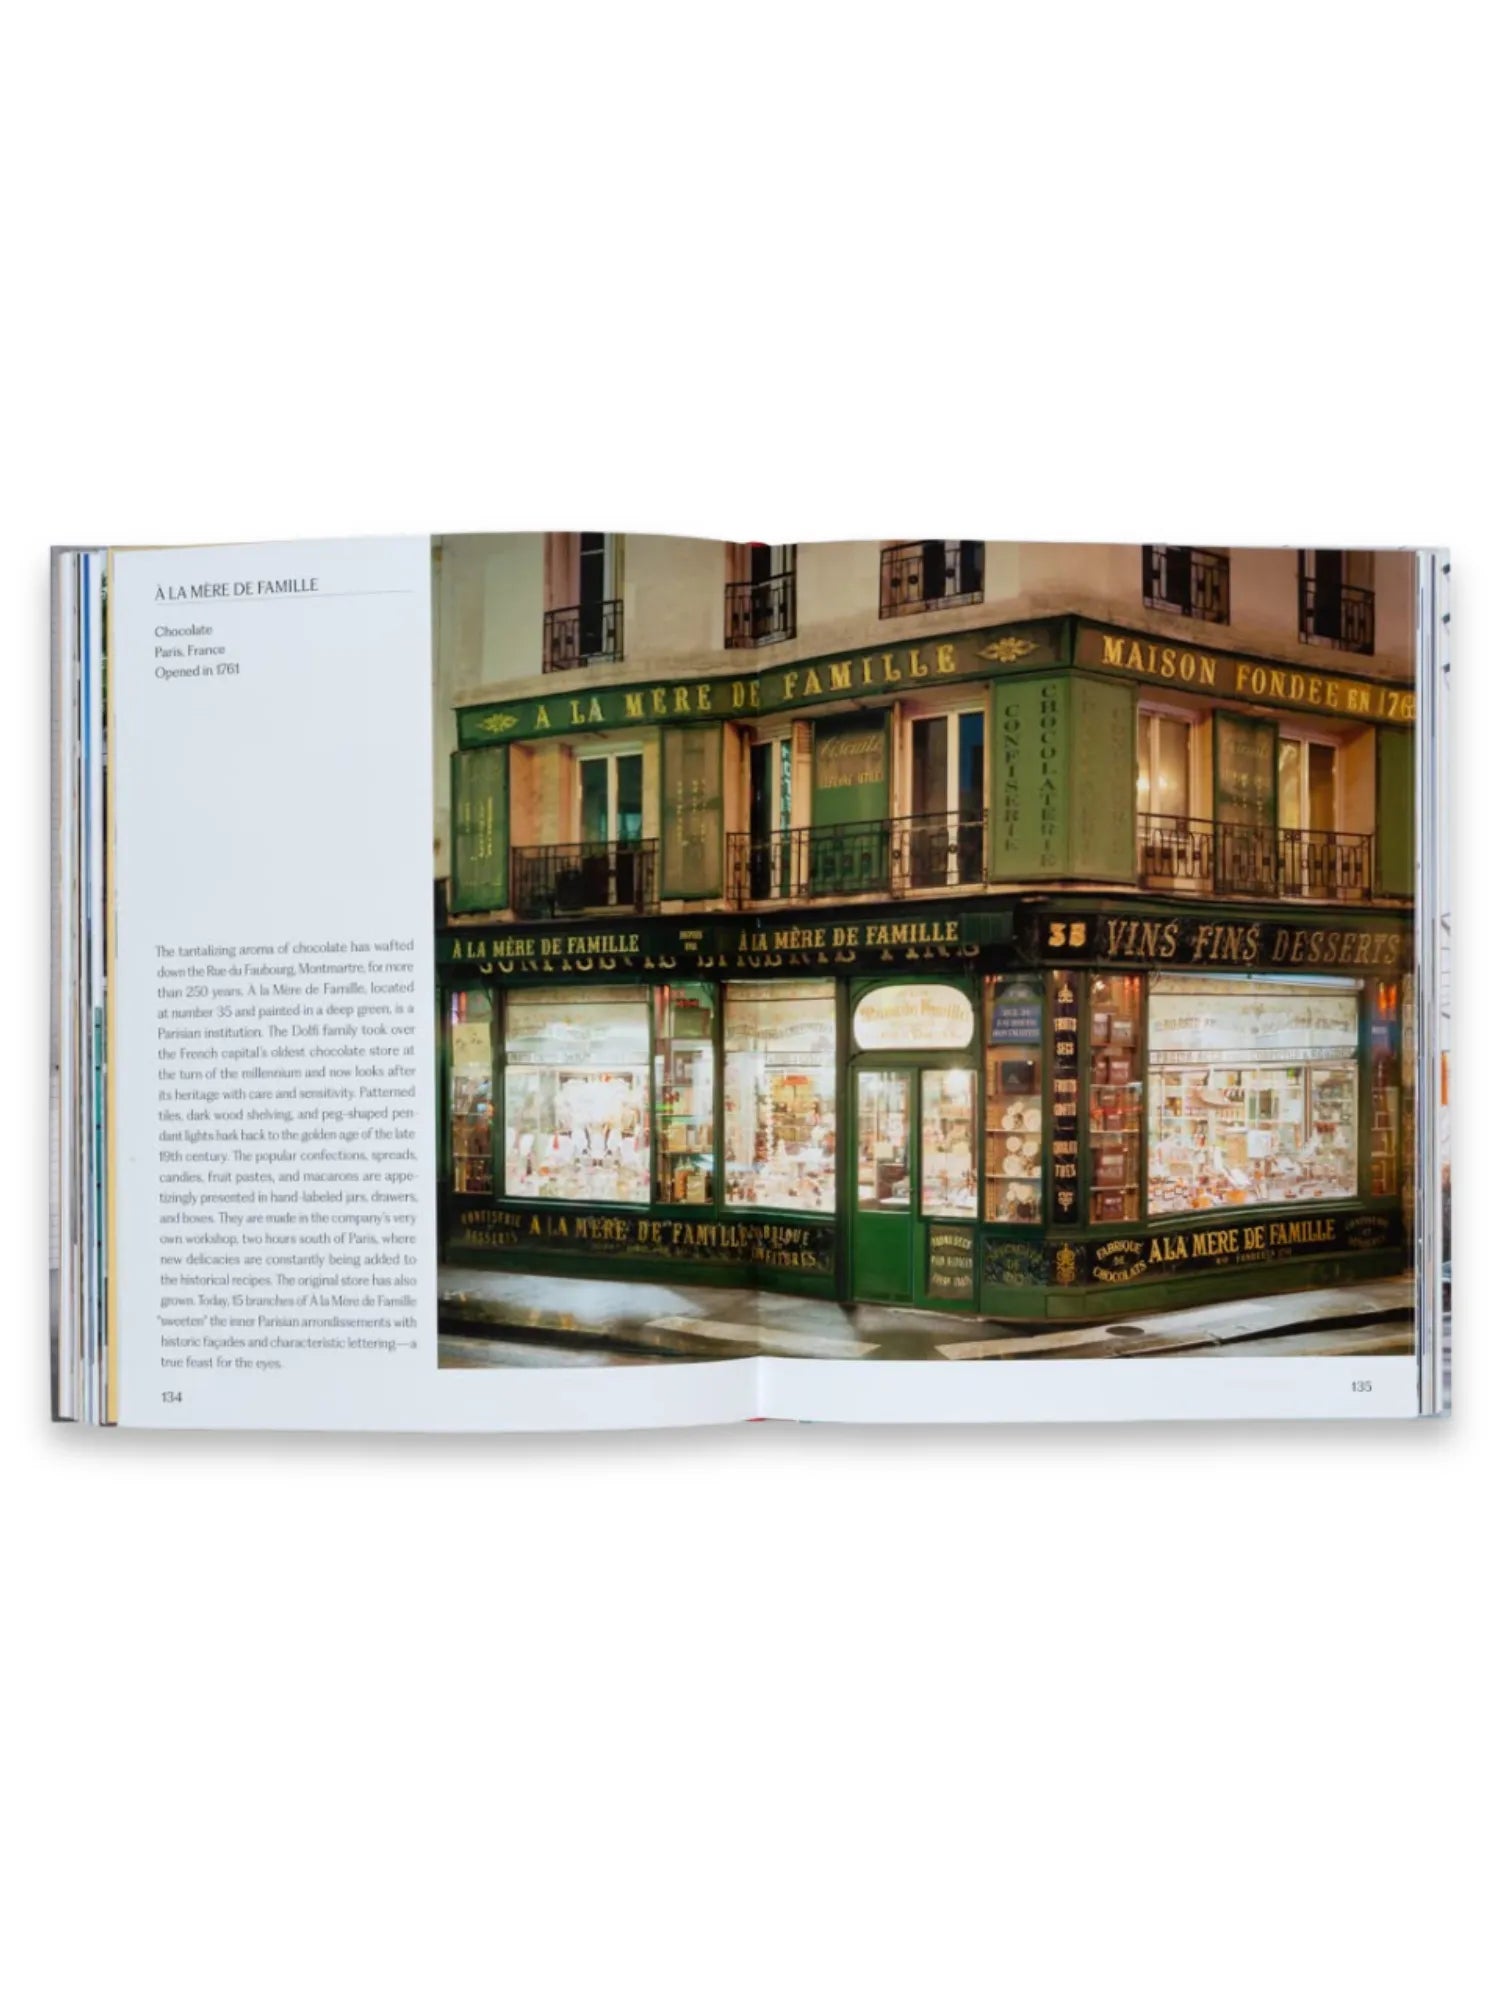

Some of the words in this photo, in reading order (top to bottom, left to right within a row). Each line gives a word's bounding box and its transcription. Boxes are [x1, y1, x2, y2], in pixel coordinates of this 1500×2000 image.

[154, 585, 165, 601] À
[168, 584, 187, 600] LA
[190, 582, 231, 599] MÈRE
[234, 580, 254, 597] DE
[256, 577, 319, 596] FAMILLE
[154, 623, 214, 636] Chocolate
[187, 643, 226, 656] France
[154, 664, 200, 681] Opened
[202, 664, 214, 677] in
[216, 663, 240, 676] 1761
[1102, 635, 1217, 686] MAISON
[1235, 663, 1339, 708] FONDEE
[1347, 687, 1371, 713] EN
[569, 697, 604, 724] LA
[732, 680, 760, 709] DE
[783, 643, 957, 701] FAMILLE
[1004, 704, 1020, 852] CONFISERIE
[1039, 684, 1057, 867] CHOCOLATERIE
[751, 932, 768, 951] LA
[773, 925, 826, 950] MÈRE
[832, 926, 859, 947] DE
[865, 920, 959, 946] FAMILLE
[1048, 922, 1086, 948] 35
[1106, 918, 1178, 959] VINS
[1191, 923, 1261, 963] FINS
[1272, 929, 1401, 964] DESSERTS
[155, 944, 176, 957] The
[178, 943, 237, 959] tantalizing
[239, 944, 275, 955] aroma
[277, 942, 290, 954] of
[292, 941, 348, 954] chocolate
[350, 940, 372, 953] has
[374, 939, 414, 953] wafted
[452, 939, 462, 960] À
[466, 941, 487, 959] LA
[492, 935, 535, 957] MÈRE
[542, 938, 562, 956] DE
[567, 934, 639, 955] FAMILLE
[157, 965, 186, 978] down
[188, 964, 205, 977] the
[207, 964, 227, 977] Rue
[229, 964, 242, 976] du
[368, 961, 383, 973] for
[385, 962, 414, 973] more
[157, 985, 183, 998] than
[185, 984, 209, 997] 250
[260, 983, 270, 996] la
[305, 982, 321, 995] de
[370, 981, 415, 994] located
[157, 1006, 169, 1019] at
[171, 1005, 214, 1019] number
[216, 1005, 233, 1018] 35
[235, 1005, 256, 1018] and
[258, 1004, 301, 1020] painted
[303, 1004, 314, 1016] in
[326, 1003, 355, 1019] deep
[394, 1002, 404, 1015] is
[158, 1026, 202, 1039] Parisian
[266, 1025, 289, 1037] The
[322, 1024, 358, 1040] family
[360, 1023, 388, 1036] took
[390, 1025, 416, 1036] over
[158, 1047, 177, 1059] the
[179, 1046, 219, 1059] French
[270, 1045, 306, 1058] oldest
[308, 1044, 367, 1058] chocolate
[369, 1044, 400, 1057] store
[402, 1044, 415, 1057] at
[186, 1108, 211, 1120] dark
[213, 1107, 244, 1120] wood
[297, 1107, 319, 1119] and
[232, 1149, 253, 1162] The
[255, 1149, 297, 1165] popular
[208, 1170, 233, 1182] fruit
[235, 1170, 275, 1185] pastes,
[277, 1170, 300, 1182] and
[302, 1172, 360, 1182] macarons
[362, 1172, 382, 1182] are
[159, 1190, 198, 1206] tizingly
[200, 1190, 256, 1206] presented
[258, 1190, 268, 1203] in
[547, 1216, 569, 1237] LA
[637, 1219, 662, 1243] DE
[673, 1221, 750, 1249] FAMILLE
[1147, 1239, 1162, 1264] A
[1163, 1235, 1189, 1260] LA
[1191, 1229, 1239, 1257] MERE
[1244, 1226, 1265, 1250] DE
[1269, 1218, 1336, 1246] FAMILLE
[1095, 1239, 1144, 1260] FABRIQUE
[160, 1255, 183, 1265] new
[185, 1252, 241, 1265] delicacies
[243, 1255, 263, 1265] are
[265, 1252, 325, 1268] constantly
[327, 1252, 361, 1268] being
[363, 1252, 401, 1265] added
[404, 1252, 418, 1265] to
[1092, 1259, 1147, 1283] CHOCOLATS
[161, 1335, 201, 1348] historic
[247, 1335, 268, 1348] and
[270, 1335, 345, 1348] characteristic
[161, 1355, 184, 1368] true
[186, 1355, 214, 1368] feast
[216, 1355, 233, 1368] for
[235, 1355, 253, 1368] the
[1351, 1380, 1373, 1393] 135
[161, 1391, 183, 1404] 134
